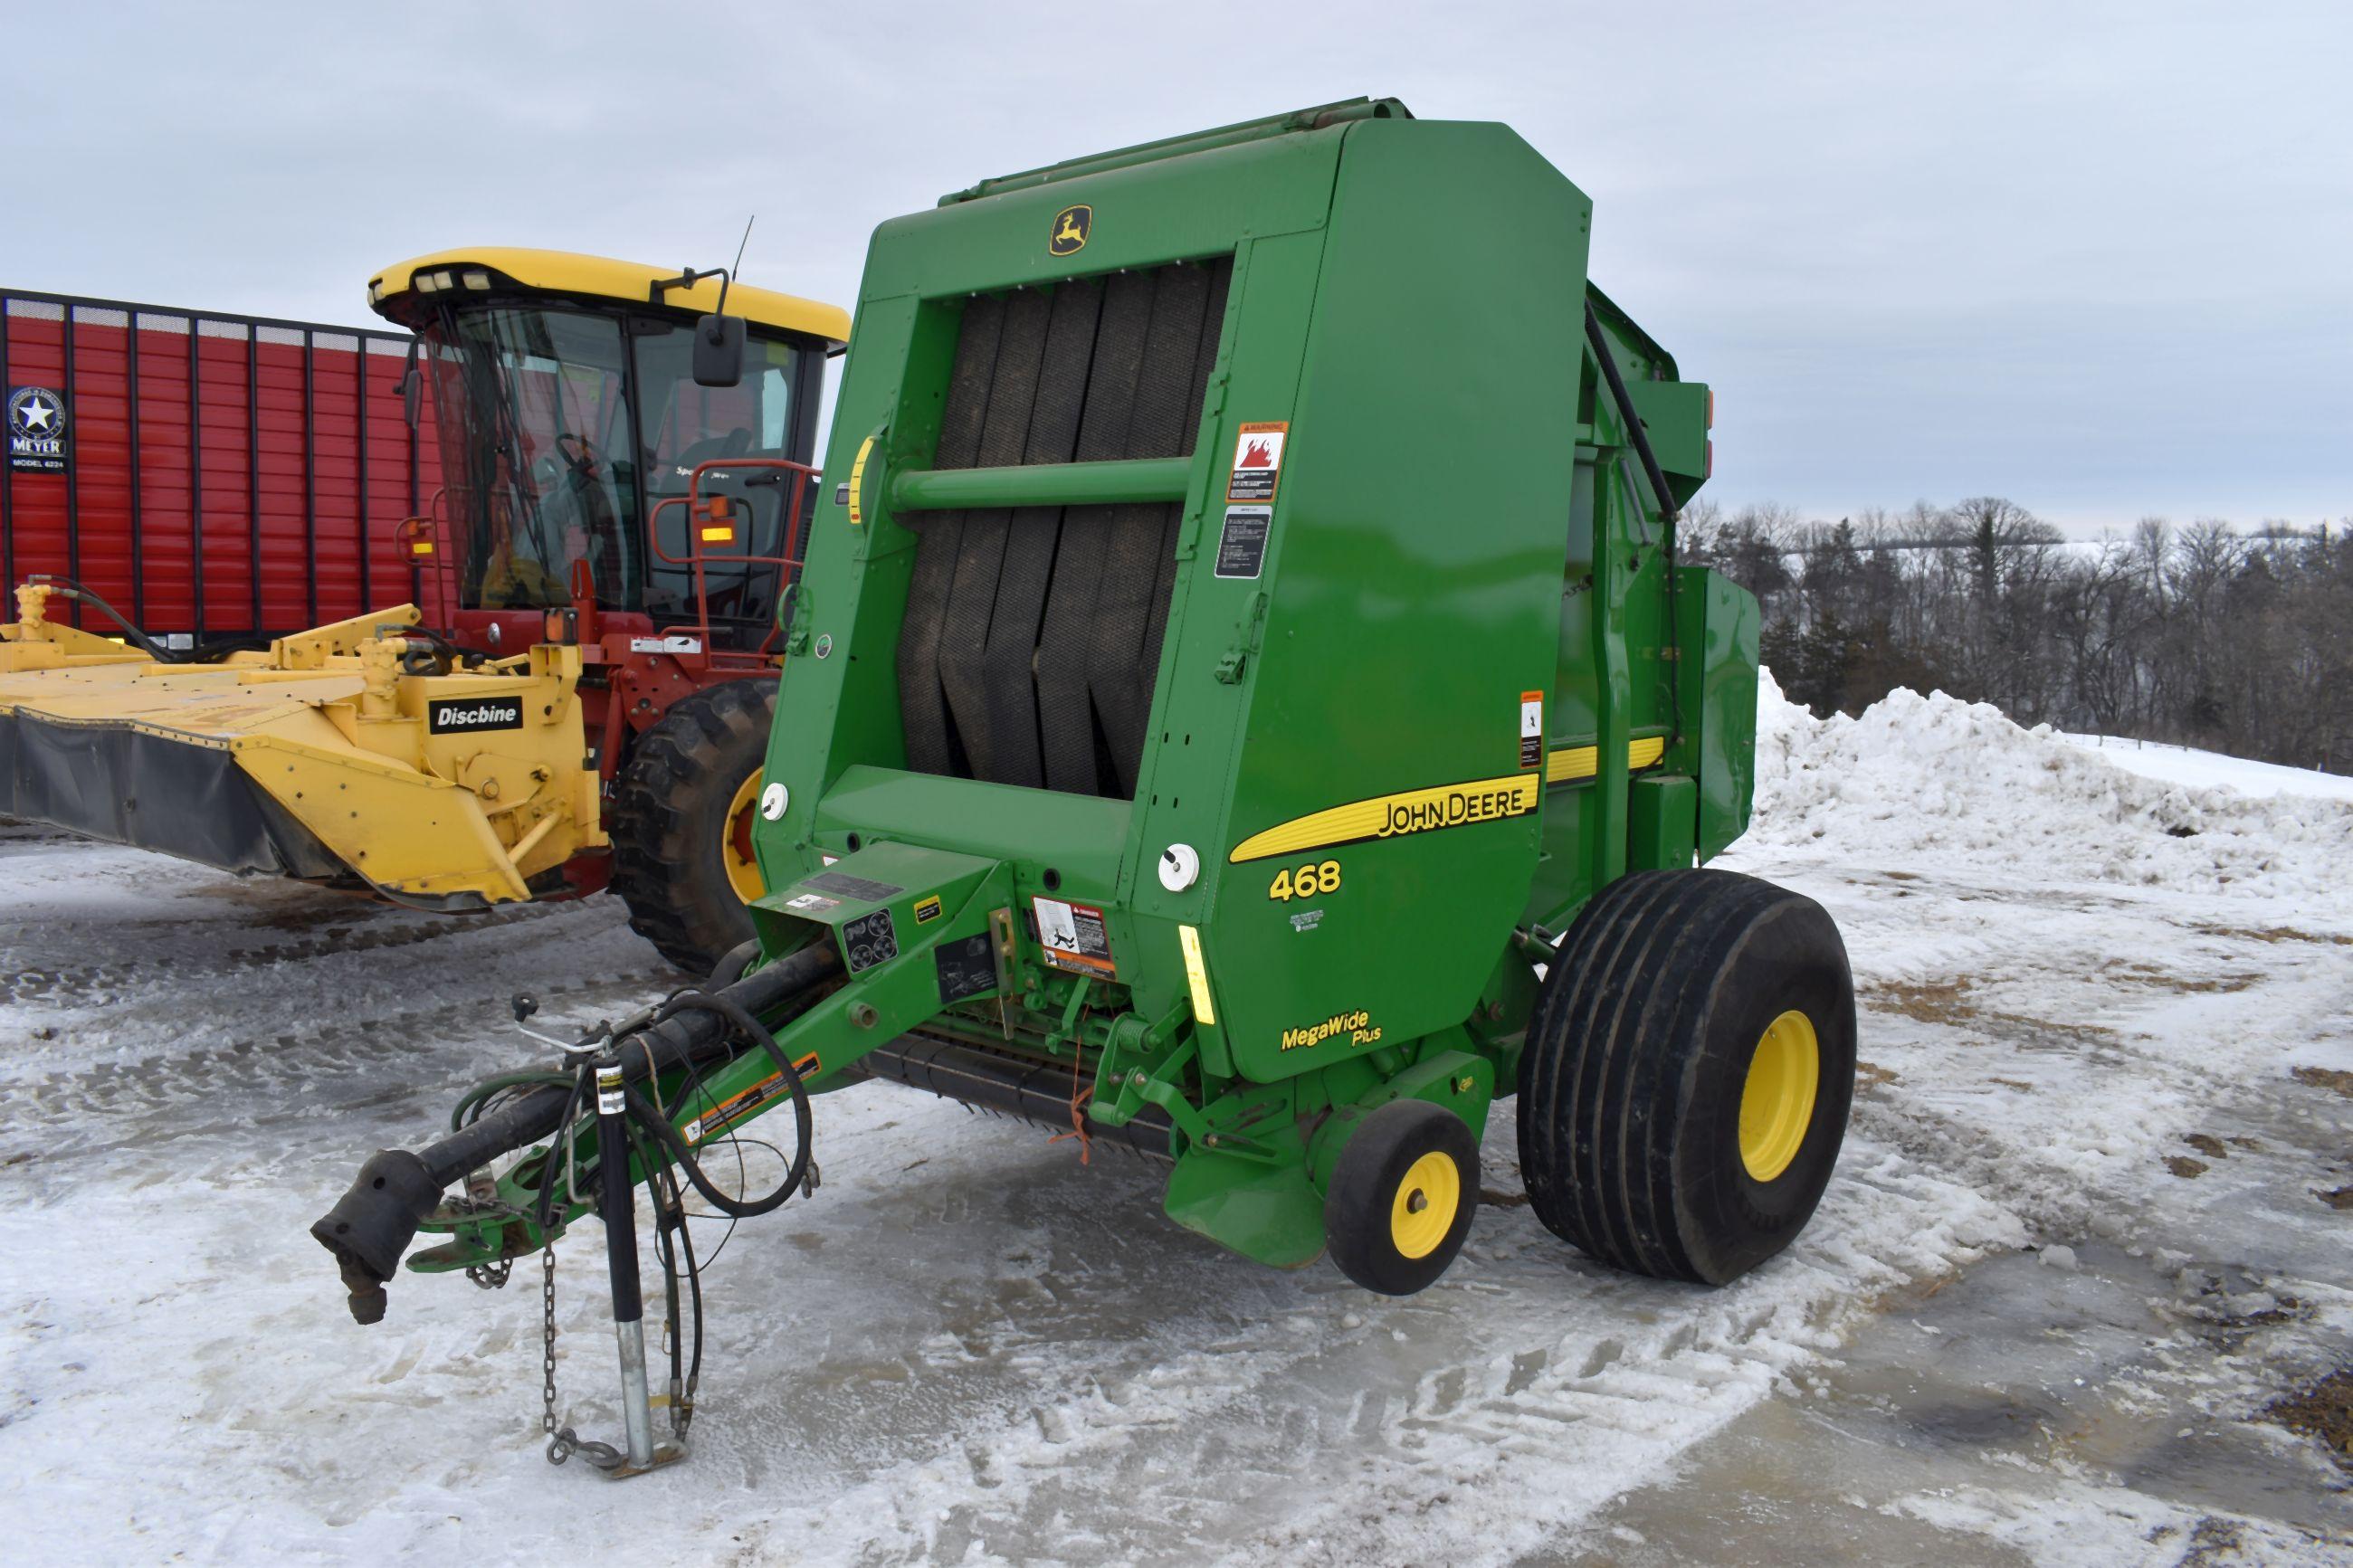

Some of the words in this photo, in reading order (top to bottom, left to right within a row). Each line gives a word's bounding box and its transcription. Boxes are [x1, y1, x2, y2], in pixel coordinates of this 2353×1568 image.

[13, 438, 60, 453] MEYER
[13, 459, 43, 468] MODEL
[437, 705, 517, 726] Discbine
[1378, 800, 1444, 834] JOHN
[1448, 788, 1524, 822] DEERE
[1269, 860, 1341, 901] 468
[1281, 1010, 1369, 1050] MegaWide
[1351, 1027, 1382, 1048] Plus
